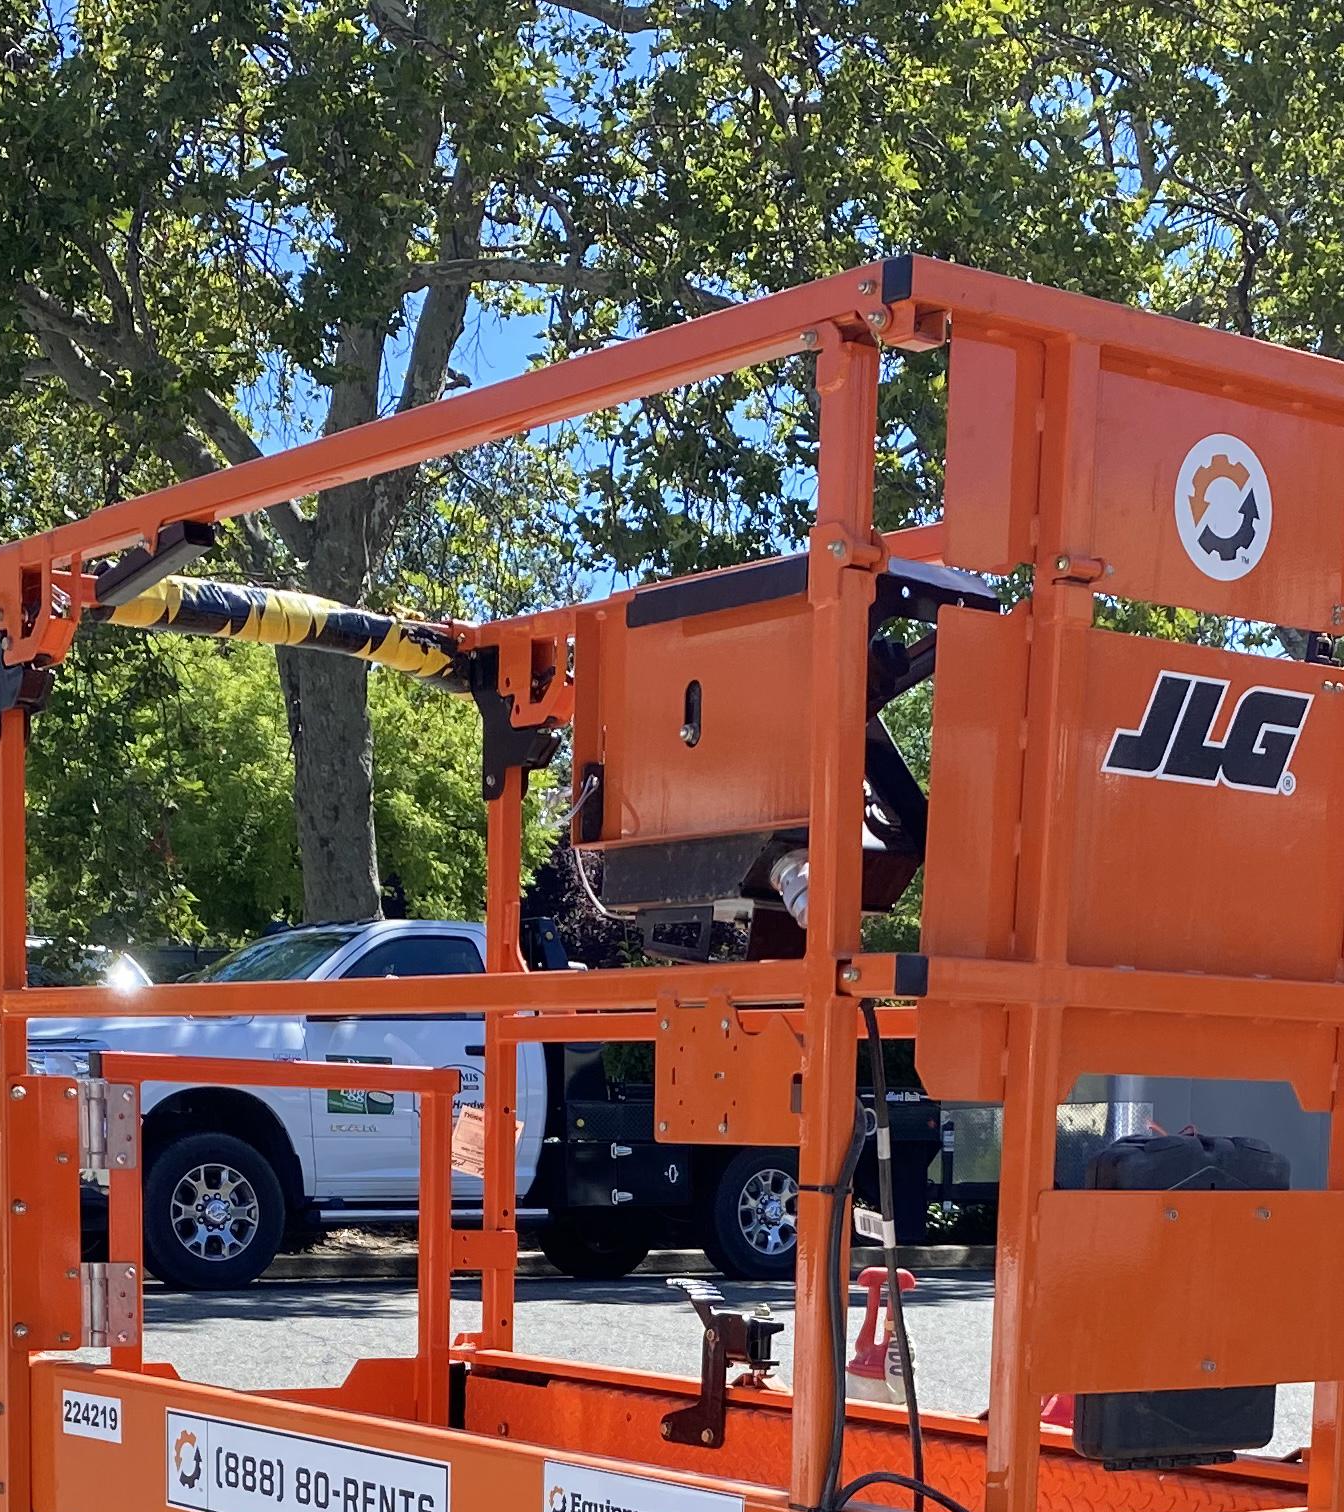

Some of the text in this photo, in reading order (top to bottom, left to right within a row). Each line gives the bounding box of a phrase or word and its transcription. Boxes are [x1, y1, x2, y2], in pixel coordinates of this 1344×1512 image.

[1102, 671, 1313, 793] JLG
[452, 1099, 485, 1110] Hardw
[64, 1400, 118, 1430] 224219
[215, 1446, 284, 1502] (888)
